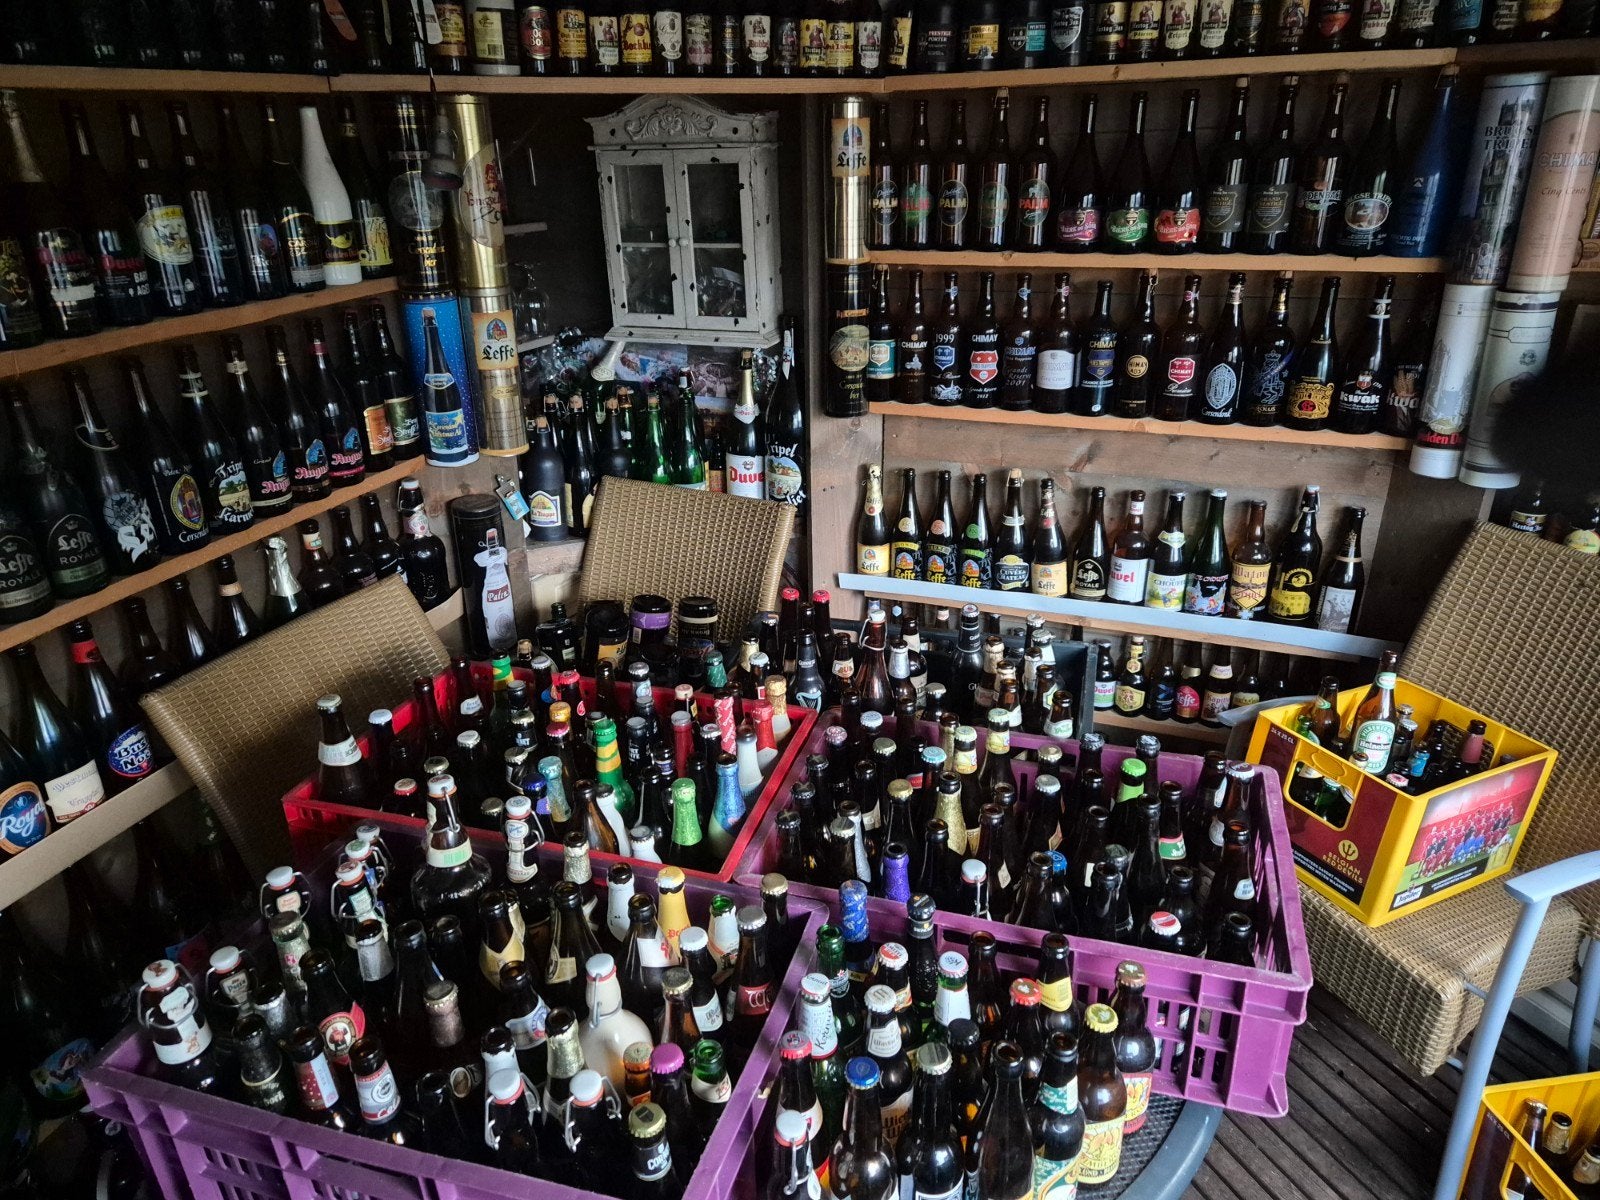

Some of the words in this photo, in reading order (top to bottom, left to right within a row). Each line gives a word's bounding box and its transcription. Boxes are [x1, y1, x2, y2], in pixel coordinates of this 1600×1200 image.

[935, 334, 955, 343] 1999
[972, 334, 998, 343] CHIMAY
[901, 341, 928, 349] CHIMAY
[1089, 341, 1117, 349] CHIMAY
[483, 345, 514, 362] Leffe
[730, 466, 765, 484] Duve
[57, 531, 93, 552] Leffe
[861, 562, 880, 571] Leffe
[1077, 568, 1099, 582] Leffe
[1109, 572, 1134, 582] uvel
[1037, 580, 1055, 589] Leffe
[1328, 851, 1361, 875] BELGIAN
[1323, 855, 1336, 866] RED
[1337, 863, 1363, 884] DEVILS
